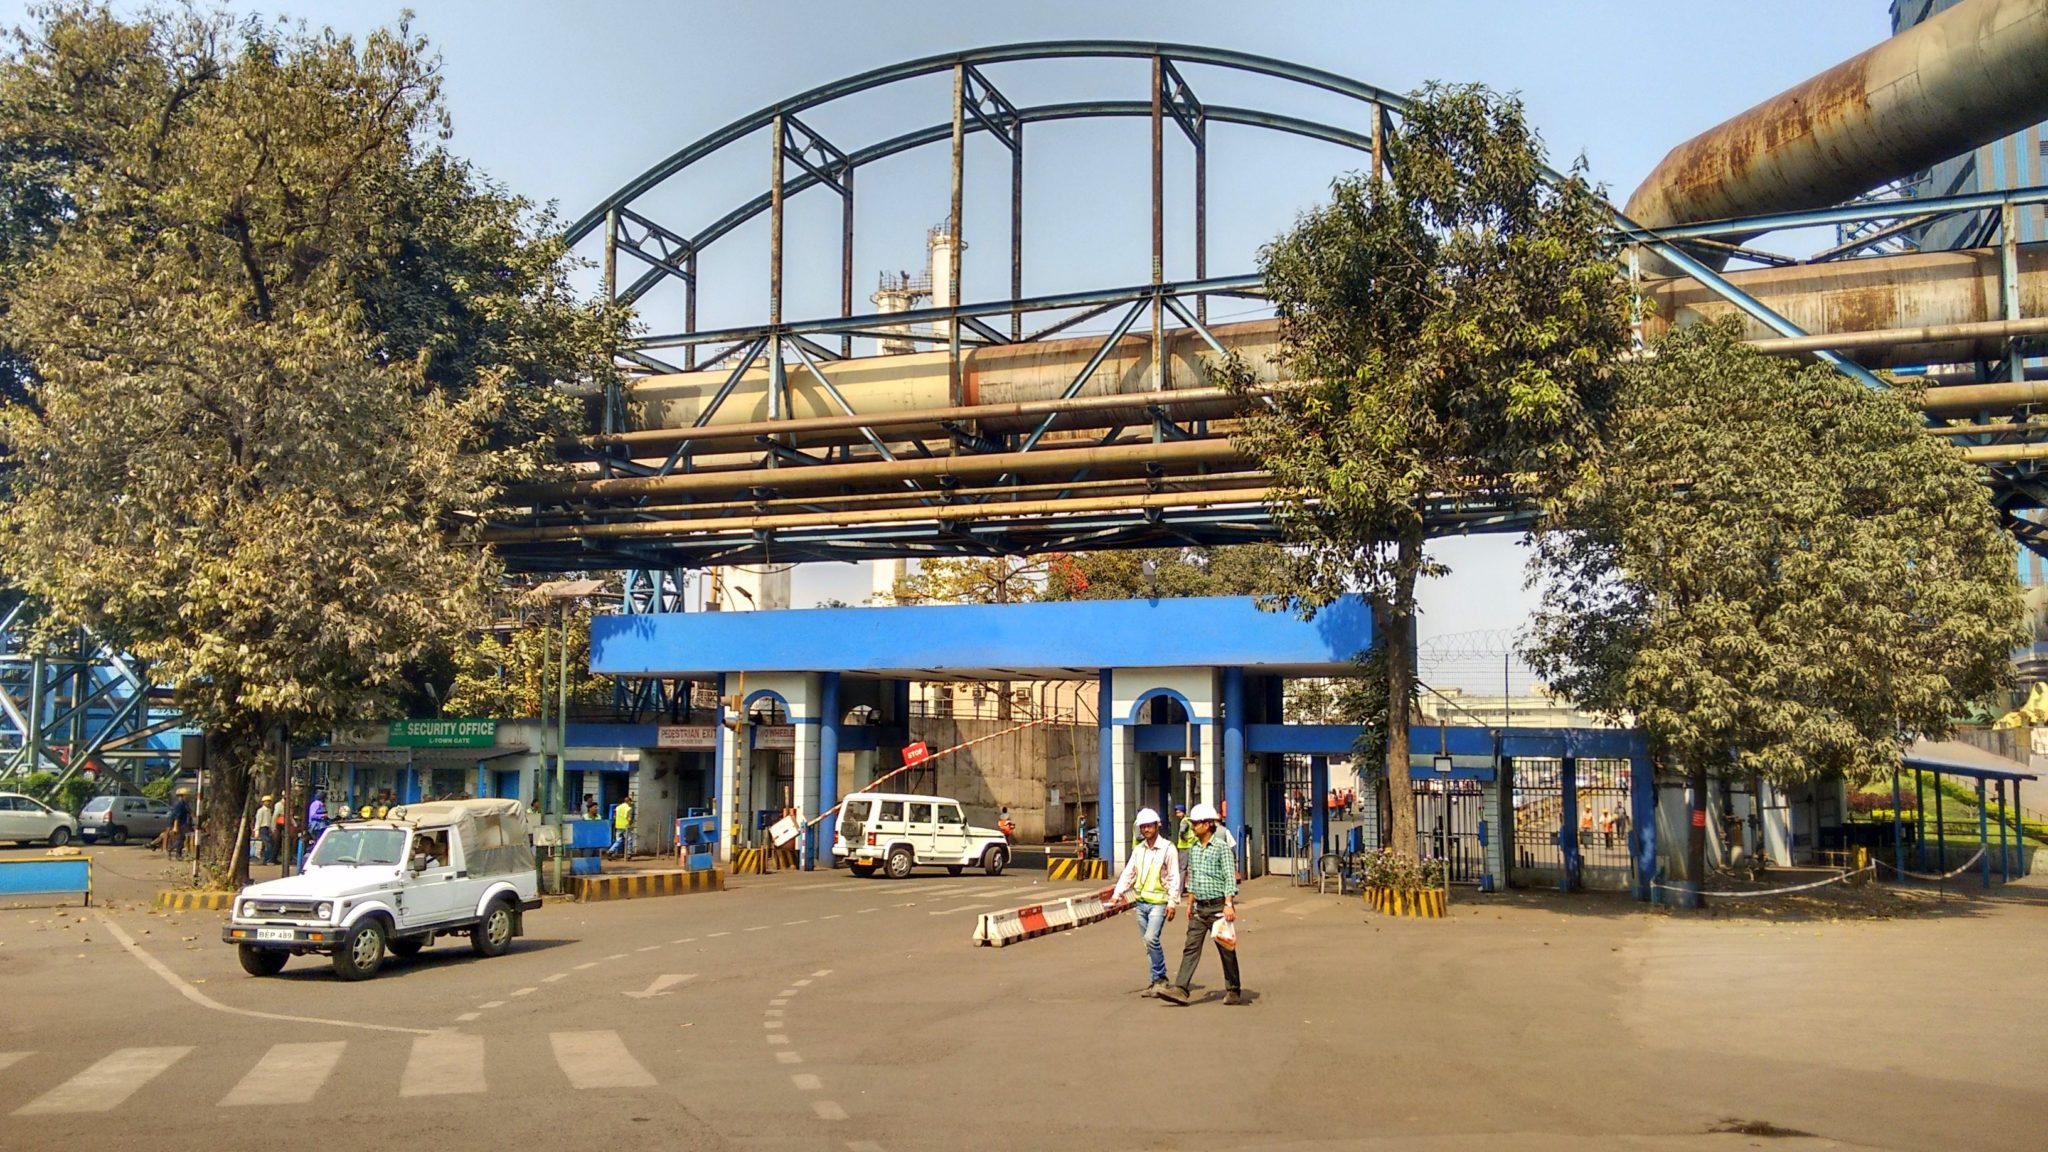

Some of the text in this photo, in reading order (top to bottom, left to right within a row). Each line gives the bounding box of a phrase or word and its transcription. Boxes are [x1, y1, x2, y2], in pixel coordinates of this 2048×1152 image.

[407, 722, 494, 736] SECURITY OFFICE
[661, 728, 700, 739] PEDESTRIAN
[907, 748, 923, 759] STOP
